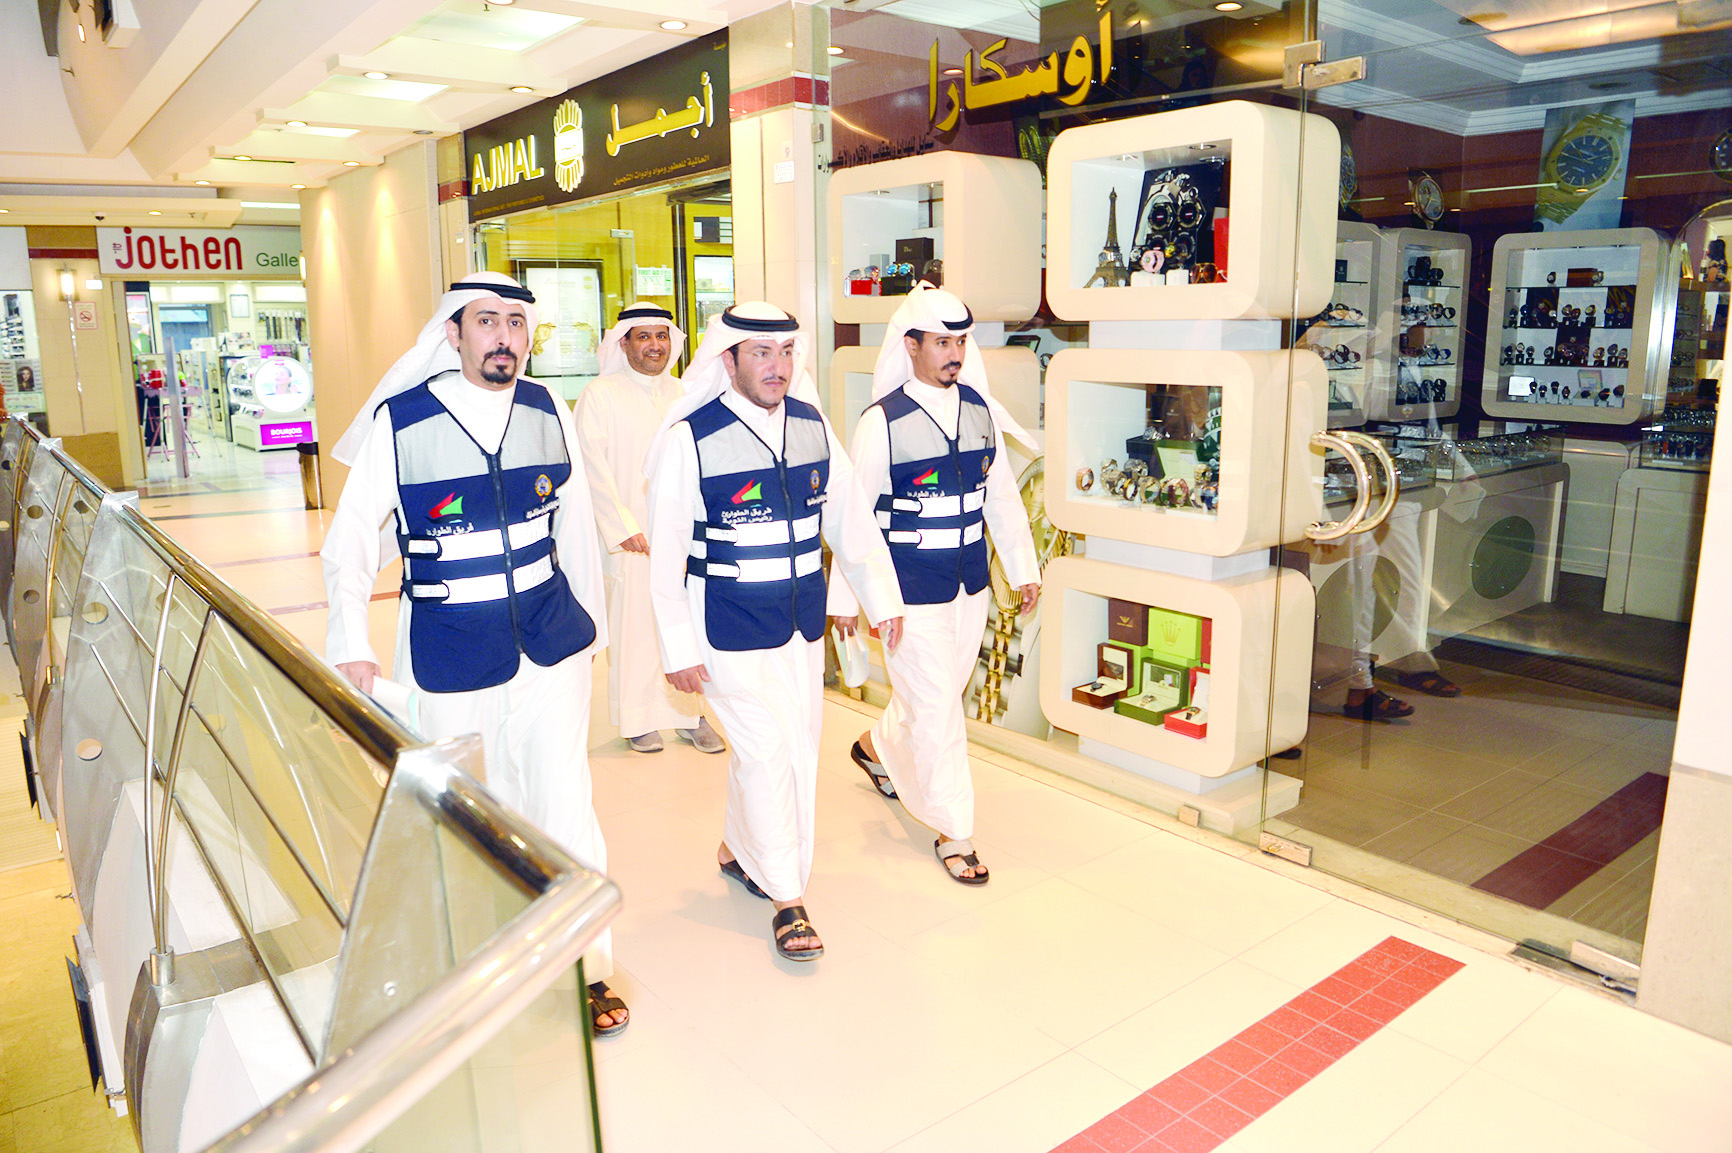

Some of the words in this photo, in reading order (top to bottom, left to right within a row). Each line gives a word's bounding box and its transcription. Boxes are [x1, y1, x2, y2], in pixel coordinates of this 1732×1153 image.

[605, 71, 714, 157] أجمل
[471, 134, 544, 195] AJMAL
[115, 226, 243, 270] jothen
[270, 427, 303, 436] BOURJOIS
[750, 507, 772, 517] فريق
[453, 522, 475, 535] فريق
